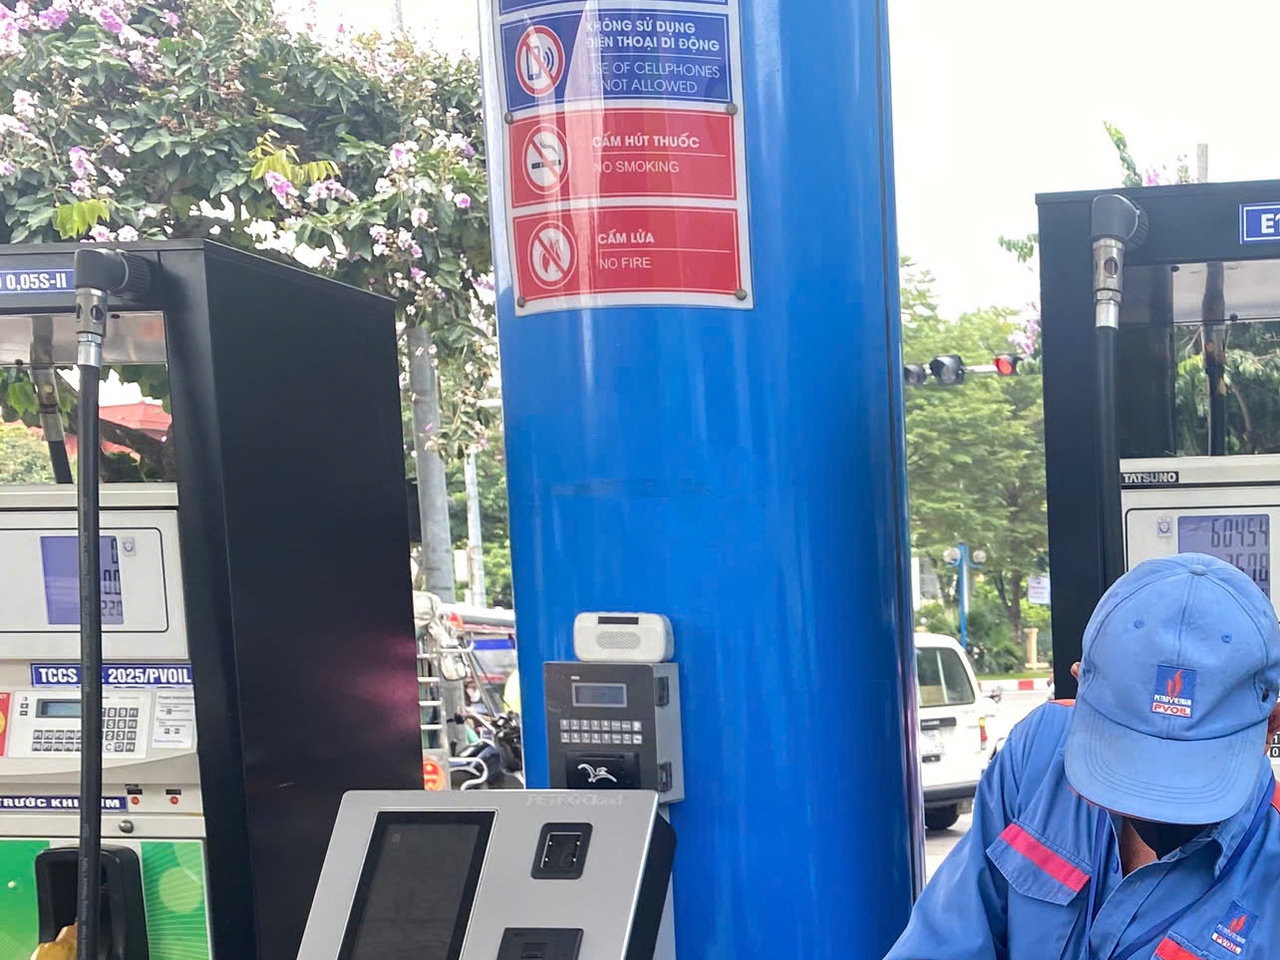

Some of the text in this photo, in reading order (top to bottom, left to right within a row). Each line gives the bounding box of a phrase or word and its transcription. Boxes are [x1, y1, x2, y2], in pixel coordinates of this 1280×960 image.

[637, 17, 653, 32] SỬ
[656, 21, 696, 36] DỤNG
[617, 36, 657, 50] THOẠI
[660, 37, 675, 49] DI
[678, 36, 720, 53] ĐỘNG
[613, 62, 630, 75] OF
[634, 62, 720, 79] CELLPHONES
[603, 80, 627, 92] NOT
[630, 80, 698, 94] ALLOWED
[593, 132, 700, 148] CẤM HÚT THUỐC
[615, 161, 680, 174] SMOKING
[598, 229, 654, 244] CẤM LỬA
[600, 257, 652, 270] NO FIRE
[1122, 472, 1178, 484] TATSUNO
[1211, 518, 1269, 548] 60454
[39, 668, 192, 684] TCCS 2025/PVOIL
[1154, 704, 1189, 716] PVOIL
[1272, 748, 1278, 756] 0
[51, 798, 79, 808] KHI
